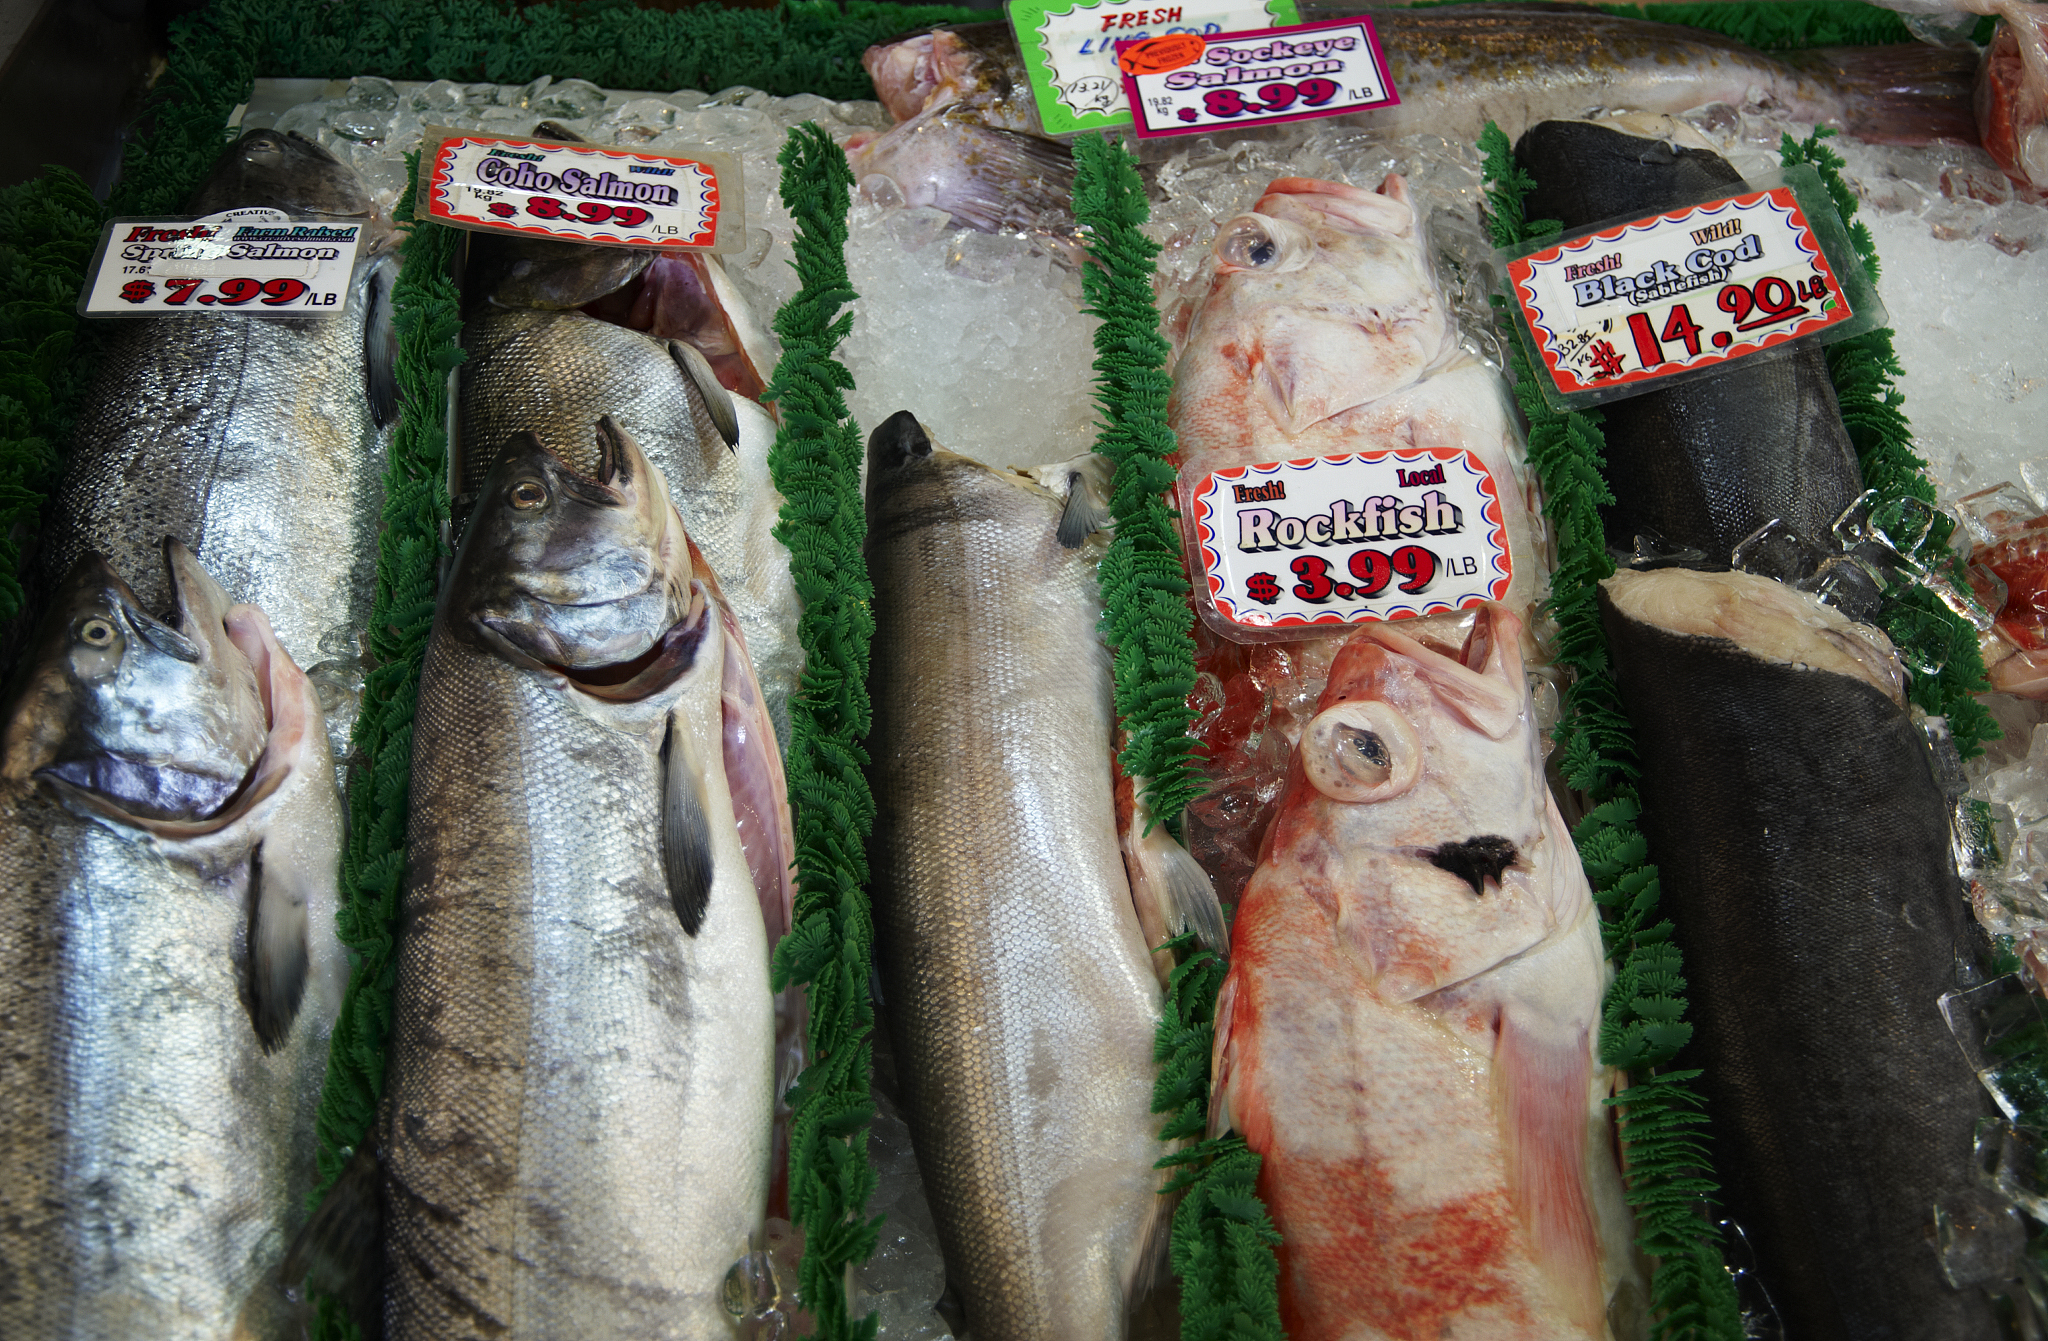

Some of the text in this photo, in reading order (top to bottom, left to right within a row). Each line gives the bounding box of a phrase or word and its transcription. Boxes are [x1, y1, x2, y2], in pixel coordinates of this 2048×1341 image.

[1101, 6, 1183, 33] FRESH
[1206, 36, 1358, 66] Sockeye
[1165, 59, 1345, 91] Salmon
[1148, 97, 1172, 106] 19.82
[1156, 104, 1169, 116] kg
[487, 148, 546, 162] Fresh!
[466, 185, 504, 197] 19.82
[477, 158, 679, 206] Coho Salmon
[473, 192, 492, 202] kg
[236, 226, 358, 238] Farm Raised
[1690, 218, 1742, 246] Wild!
[226, 243, 340, 260] Salmon
[1564, 252, 1622, 282] Fresh!
[1573, 233, 1765, 307] Black Cod
[1628, 265, 1732, 306] (Sablefish)
[1396, 464, 1446, 488] Local
[1233, 480, 1287, 503] Fresh!
[1237, 490, 1465, 554] Rockfish
